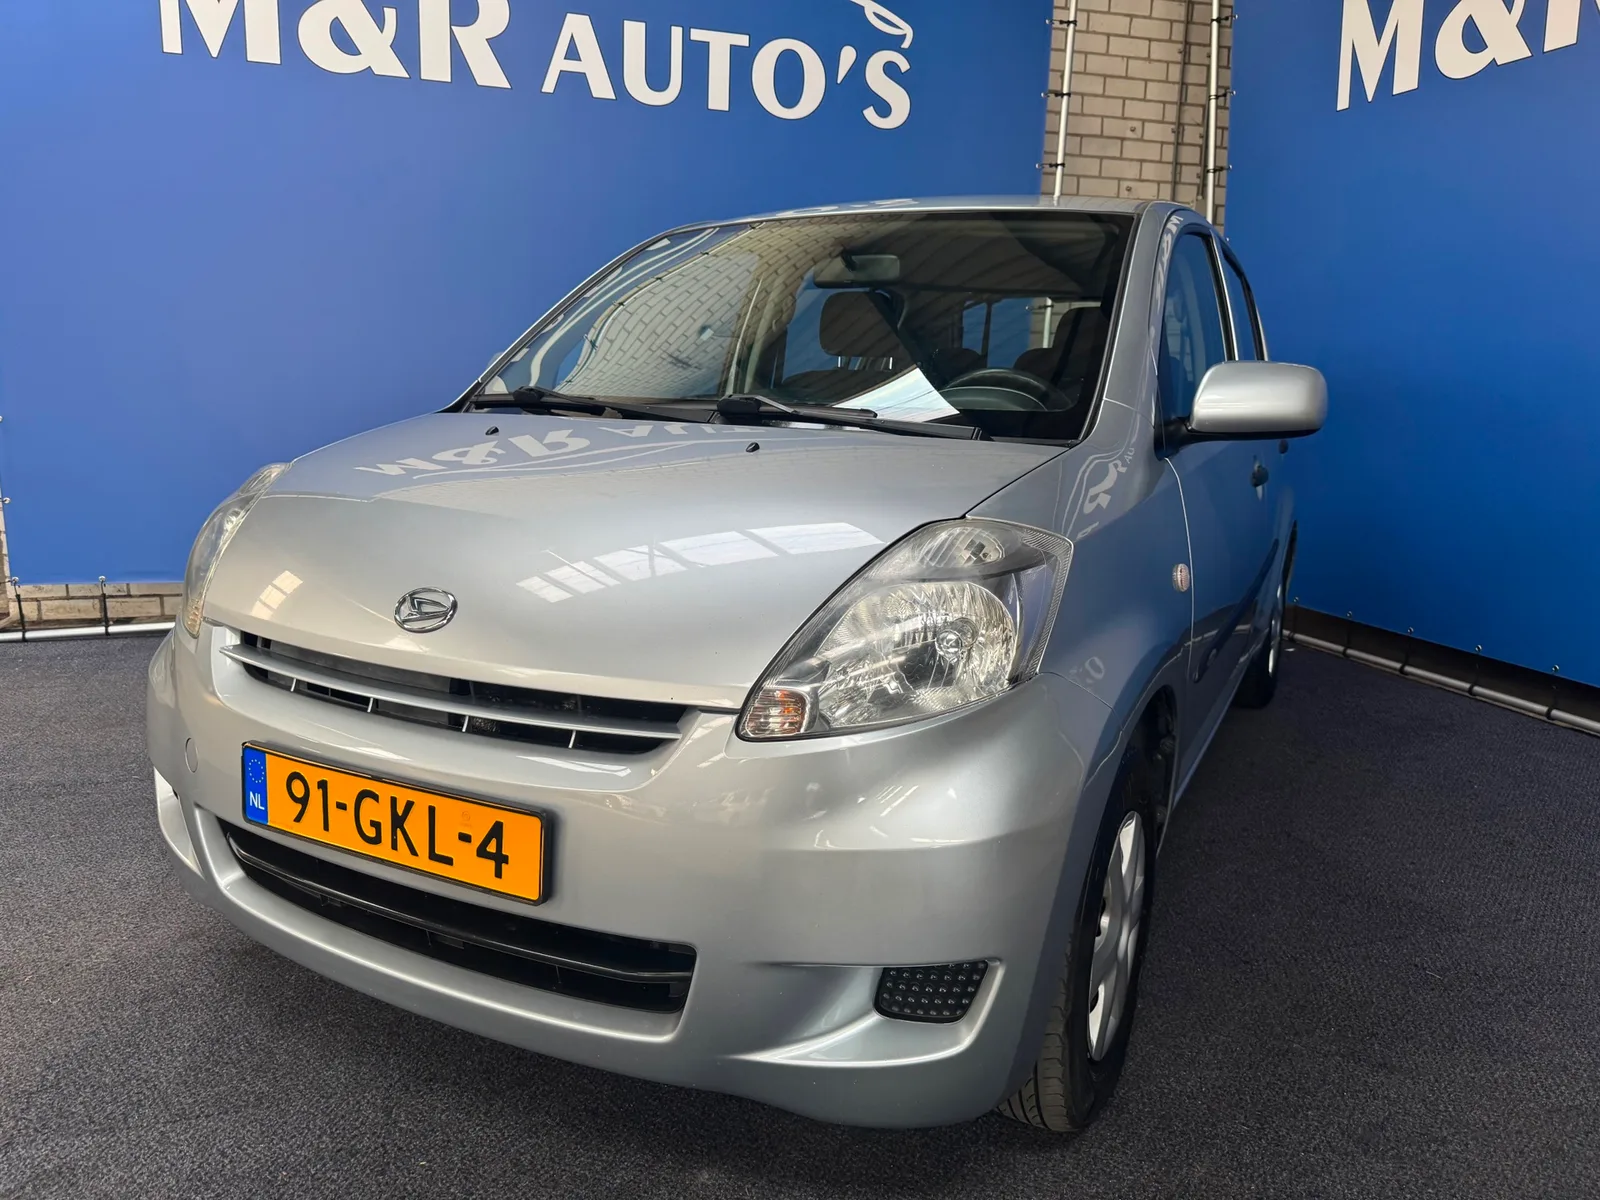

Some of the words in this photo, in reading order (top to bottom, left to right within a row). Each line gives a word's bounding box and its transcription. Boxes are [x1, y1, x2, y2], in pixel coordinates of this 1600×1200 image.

[160, 0, 512, 89] M&R
[540, 13, 912, 131] AUTO'S
[249, 790, 265, 811] NL
[285, 771, 510, 880] 91-GKL-4
